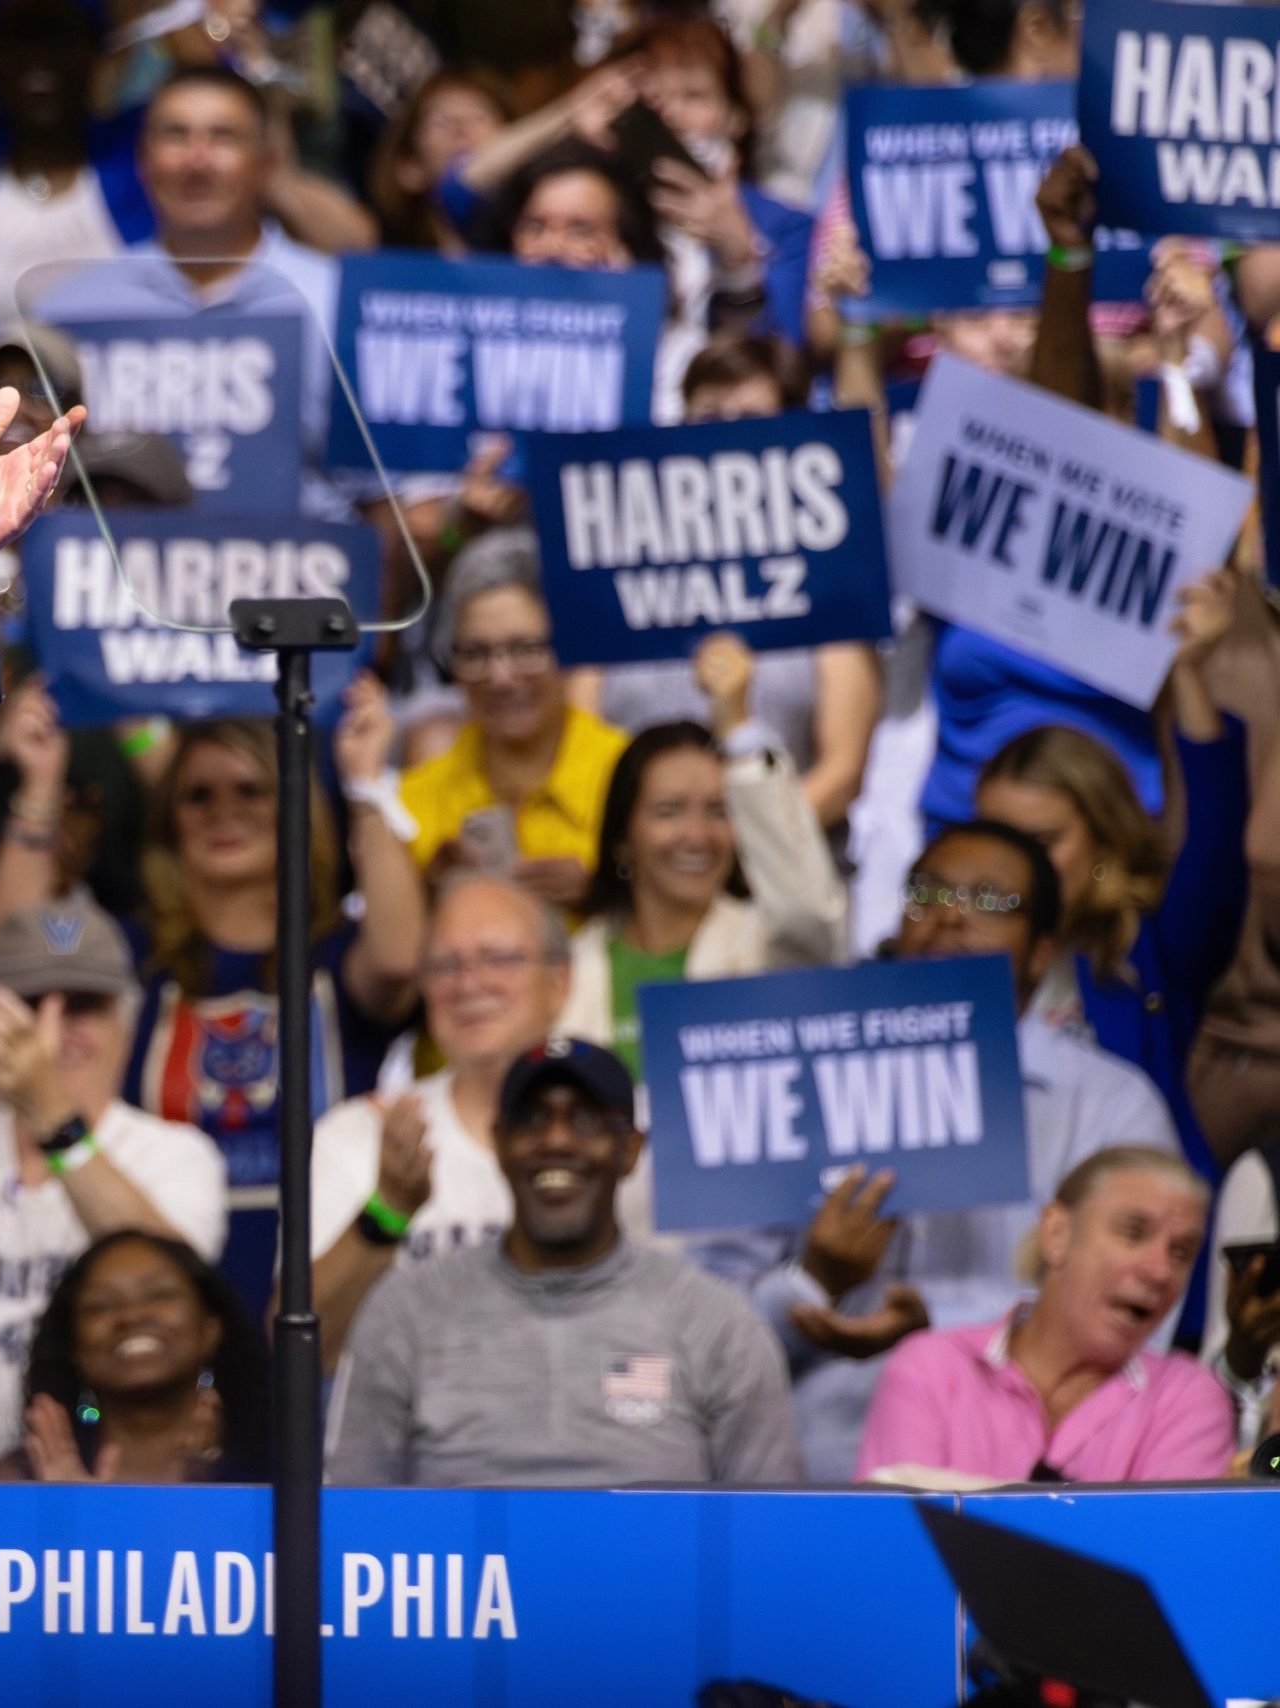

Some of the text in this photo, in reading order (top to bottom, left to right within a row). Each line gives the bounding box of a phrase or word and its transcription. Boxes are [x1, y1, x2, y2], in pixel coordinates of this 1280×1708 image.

[1110, 28, 1280, 145] HAR
[864, 121, 970, 164] WHEN
[971, 118, 1027, 160] WE
[1156, 139, 1280, 210] WA
[862, 158, 980, 260] WE
[359, 289, 463, 331] WHEN
[466, 294, 519, 335] WE
[355, 326, 627, 434] WE WIN
[559, 441, 850, 571] HARRIS
[961, 414, 1187, 533] WHEN WE VOTE
[53, 536, 351, 630] HARRIS
[929, 450, 1178, 633] WE WIN
[612, 553, 812, 631] WALZ
[99, 630, 279, 684] WAL
[679, 1018, 795, 1062] WHEN
[796, 1012, 858, 1051] WE
[862, 1001, 975, 1047] FIGHT
[679, 1040, 985, 1168] WE WIN
